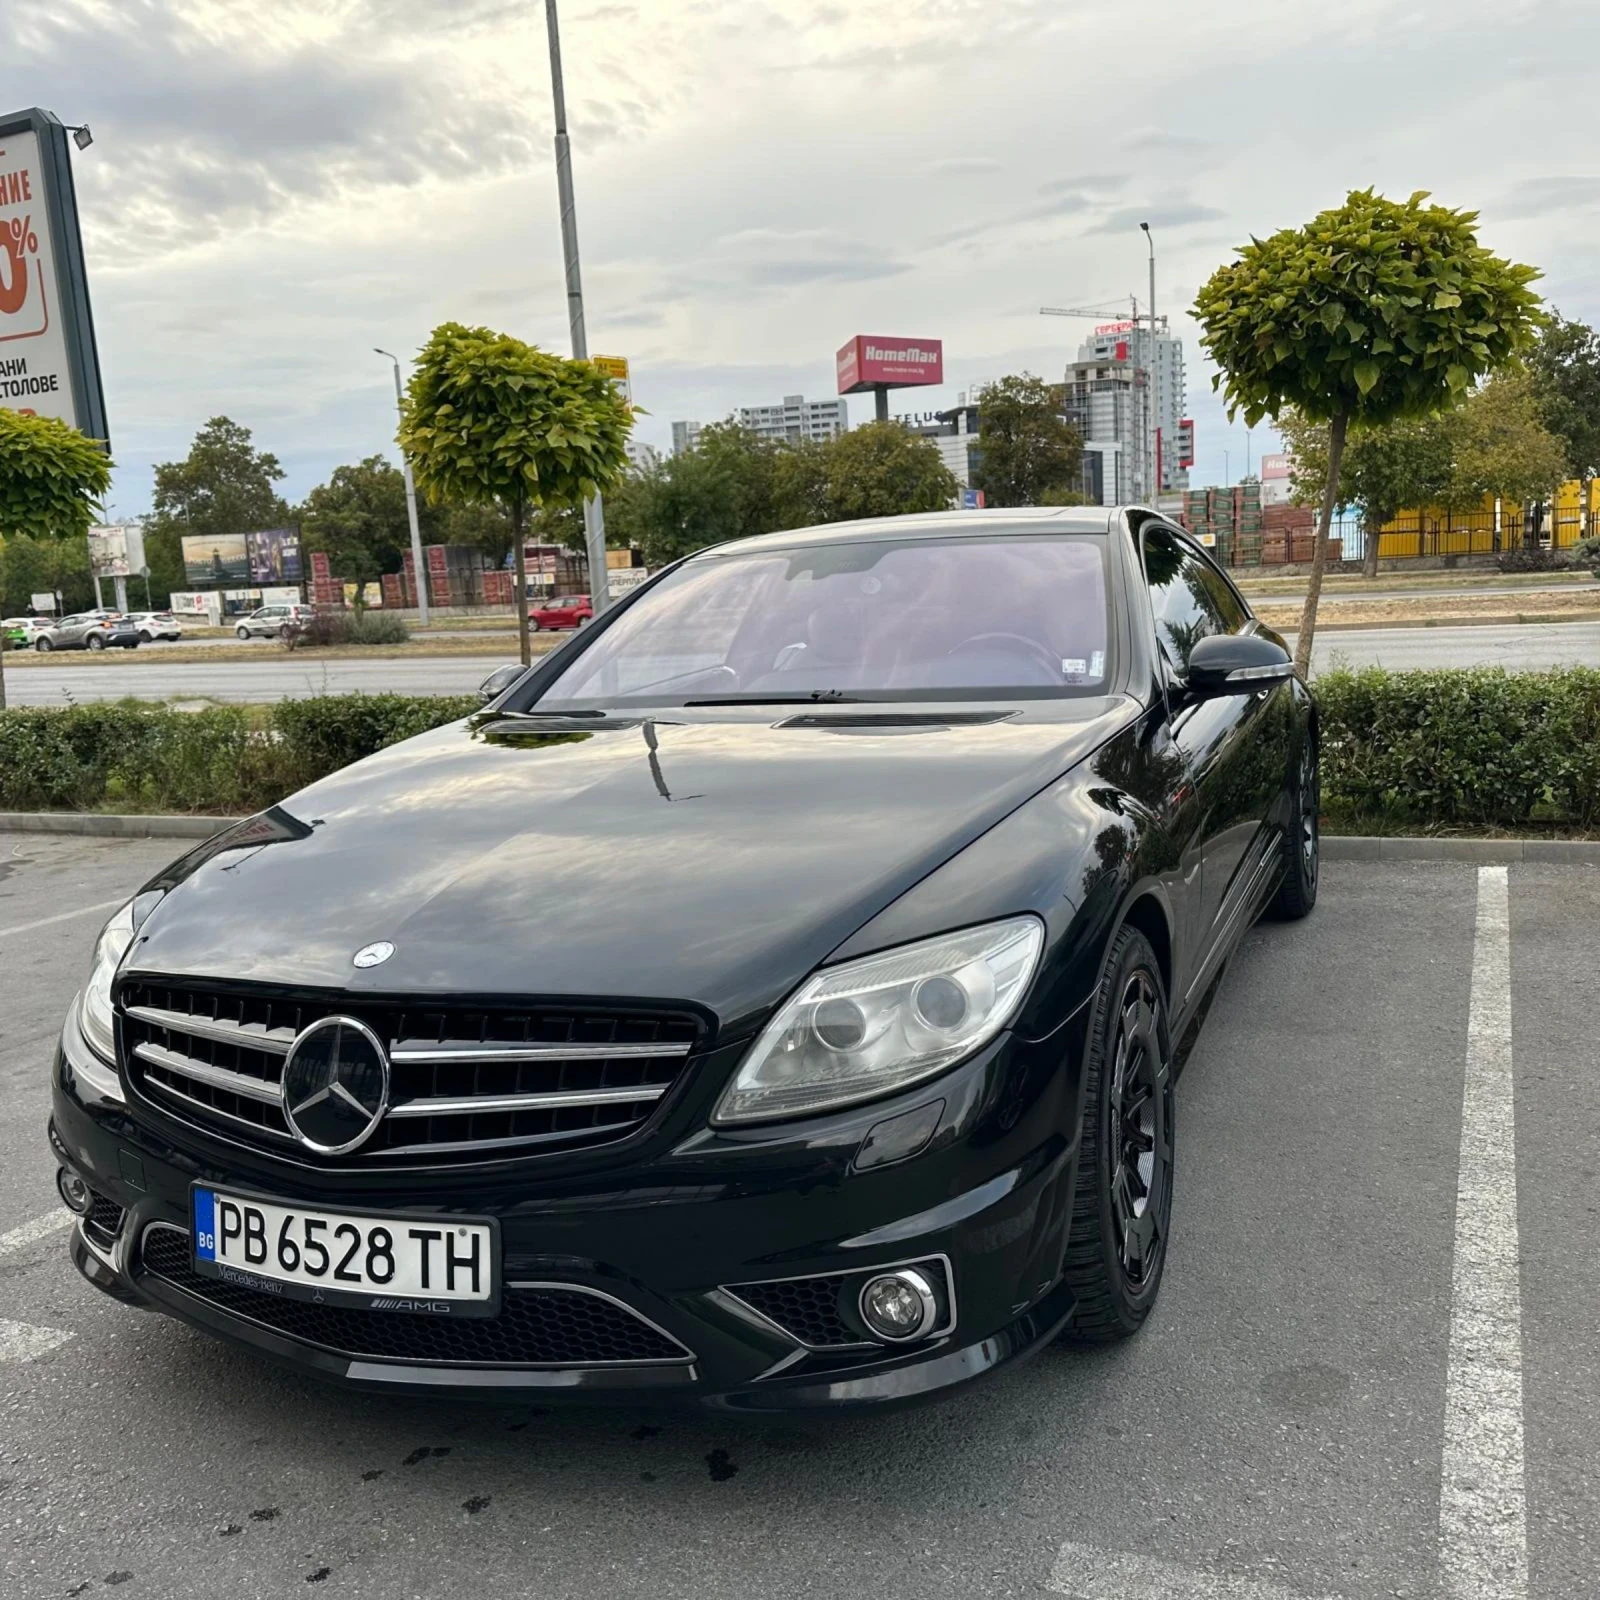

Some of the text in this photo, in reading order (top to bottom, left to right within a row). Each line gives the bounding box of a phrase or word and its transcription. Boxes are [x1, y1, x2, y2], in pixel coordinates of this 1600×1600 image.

[865, 345, 938, 363] HomeMax
[0, 374, 59, 399] ТОЛОВЕ
[199, 1231, 214, 1250] BG
[219, 1200, 480, 1293] PB 6528 TH
[217, 1264, 284, 1294] Mercedes-Benz
[395, 1300, 450, 1313] AMG
